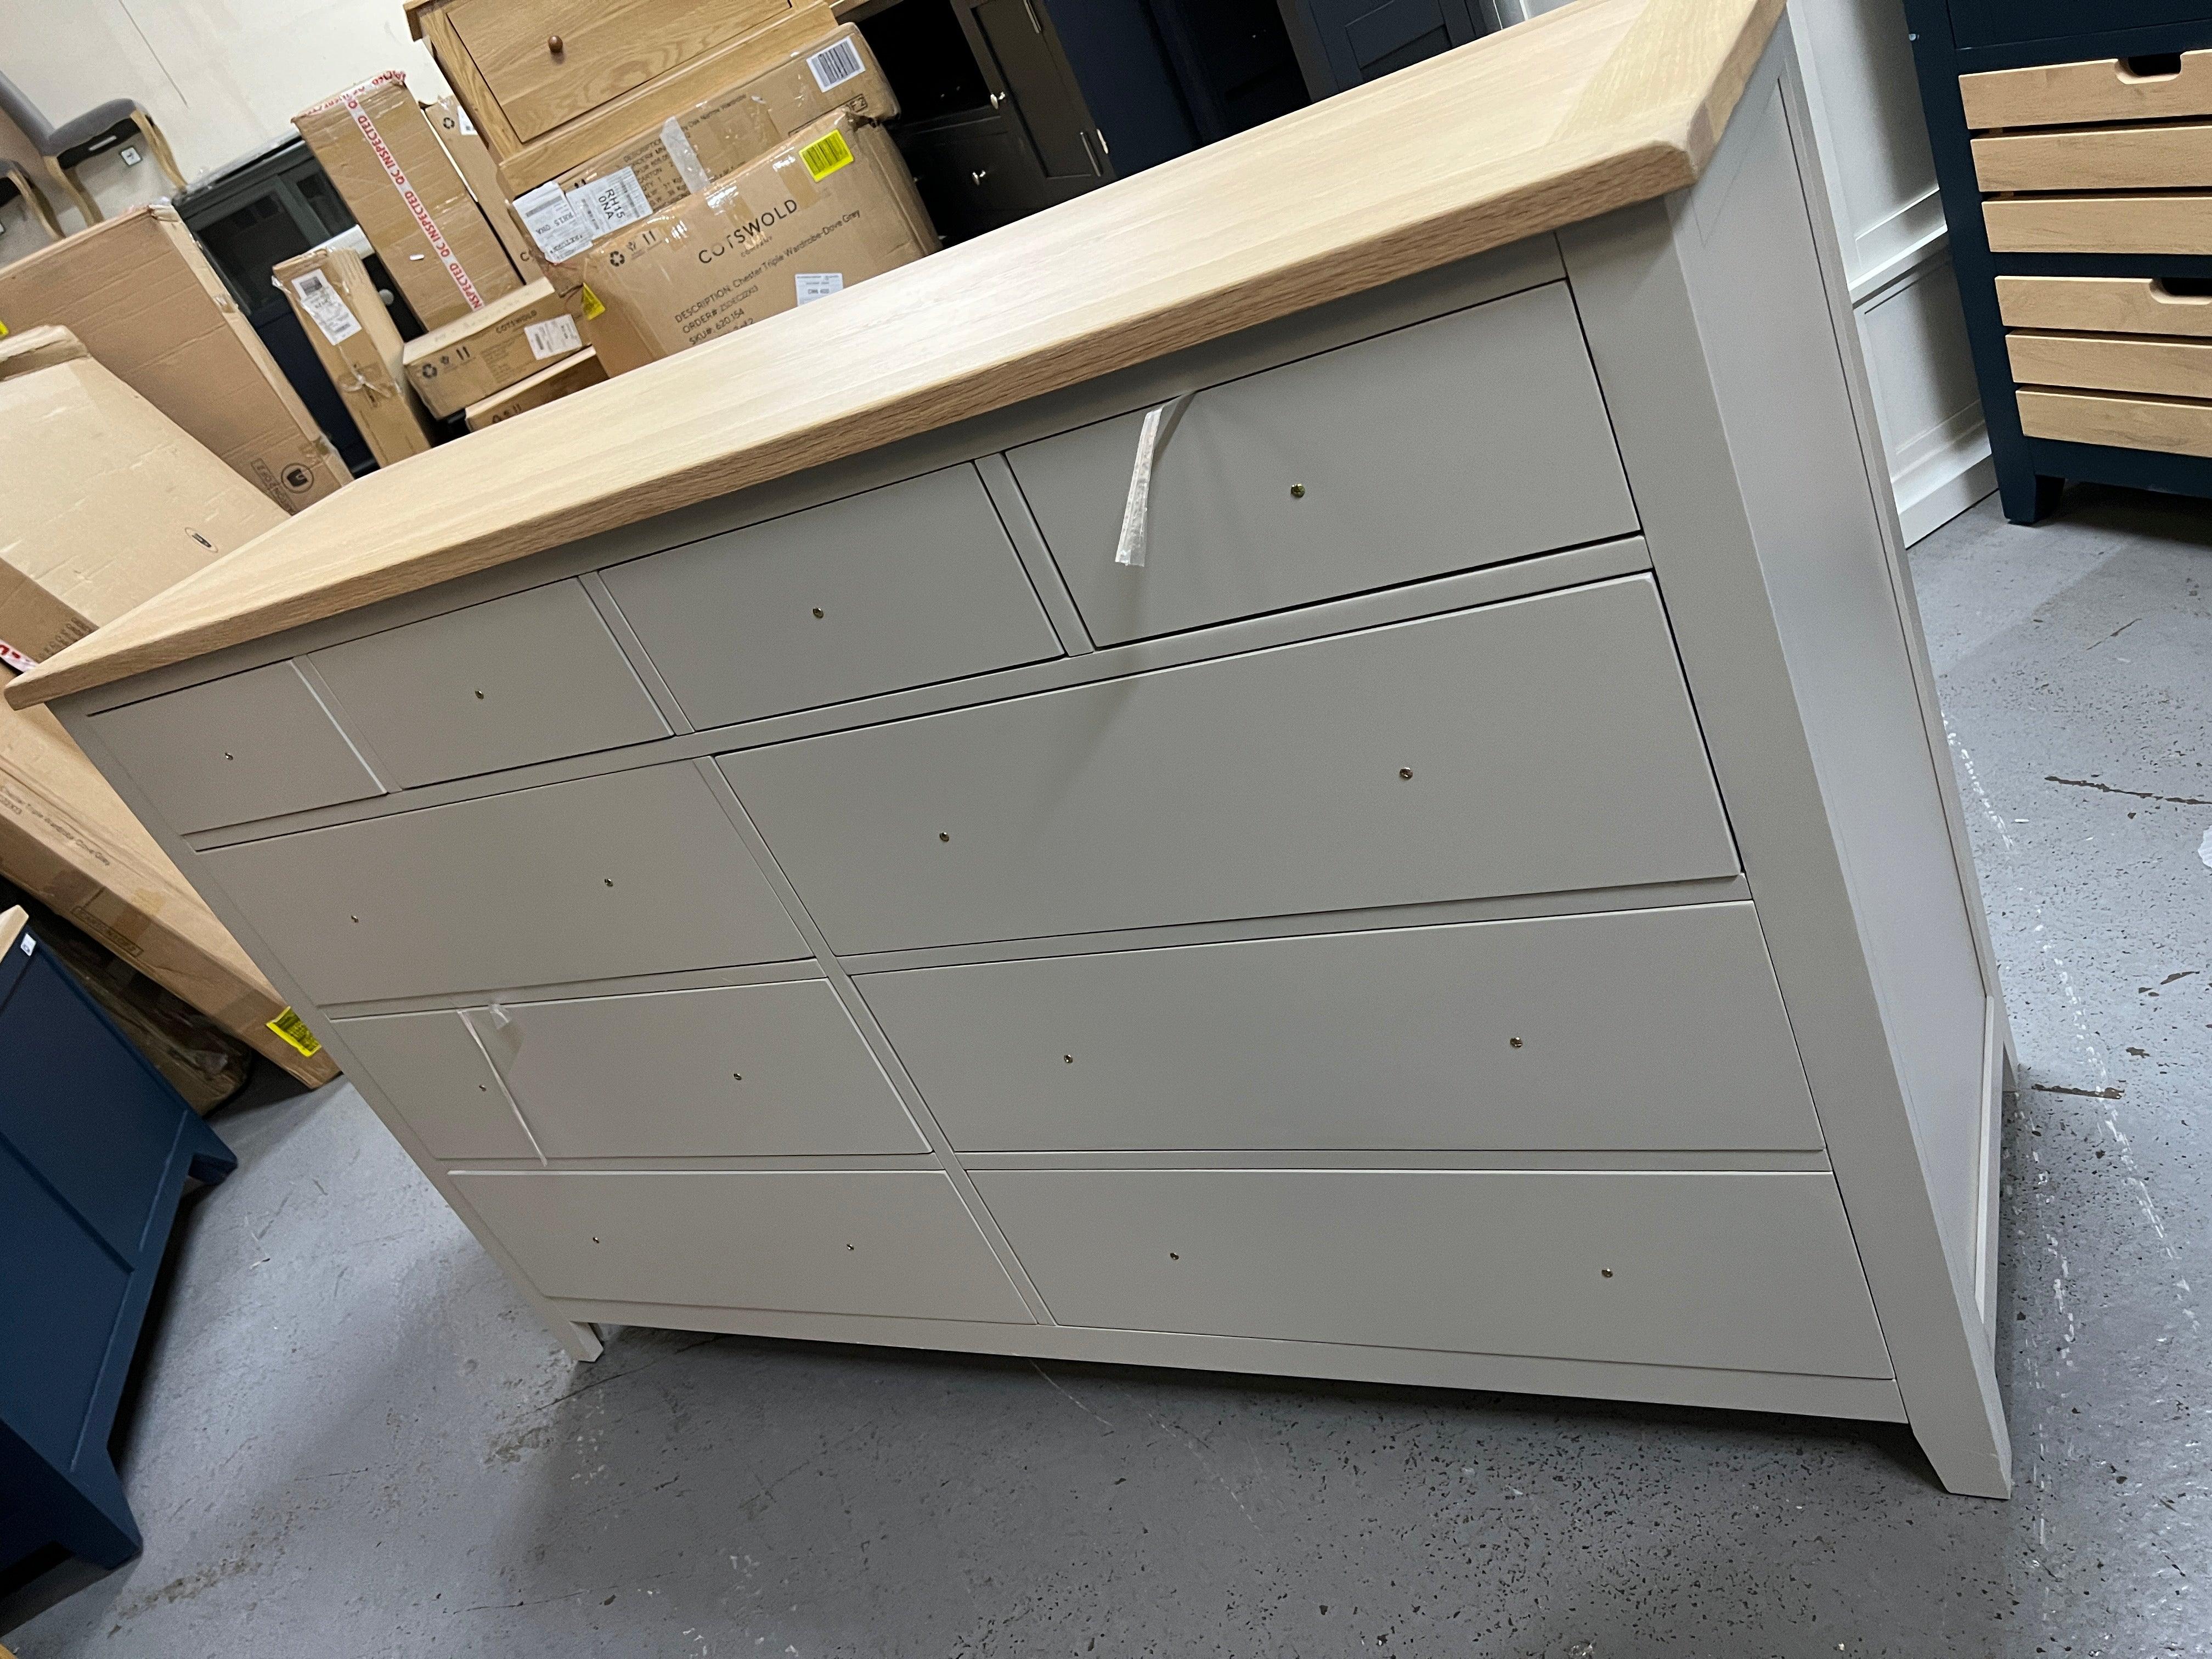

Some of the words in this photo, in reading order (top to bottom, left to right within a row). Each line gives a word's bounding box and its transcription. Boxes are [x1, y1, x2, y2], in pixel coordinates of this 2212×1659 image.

[358, 115, 396, 169] INSPECTED
[391, 170, 405, 185] QC
[405, 191, 442, 242] INSPECTED
[605, 189, 625, 219] RH15
[436, 242, 450, 258] QC
[698, 199, 798, 264] COTSWOLD
[449, 263, 482, 309] NSPECTED
